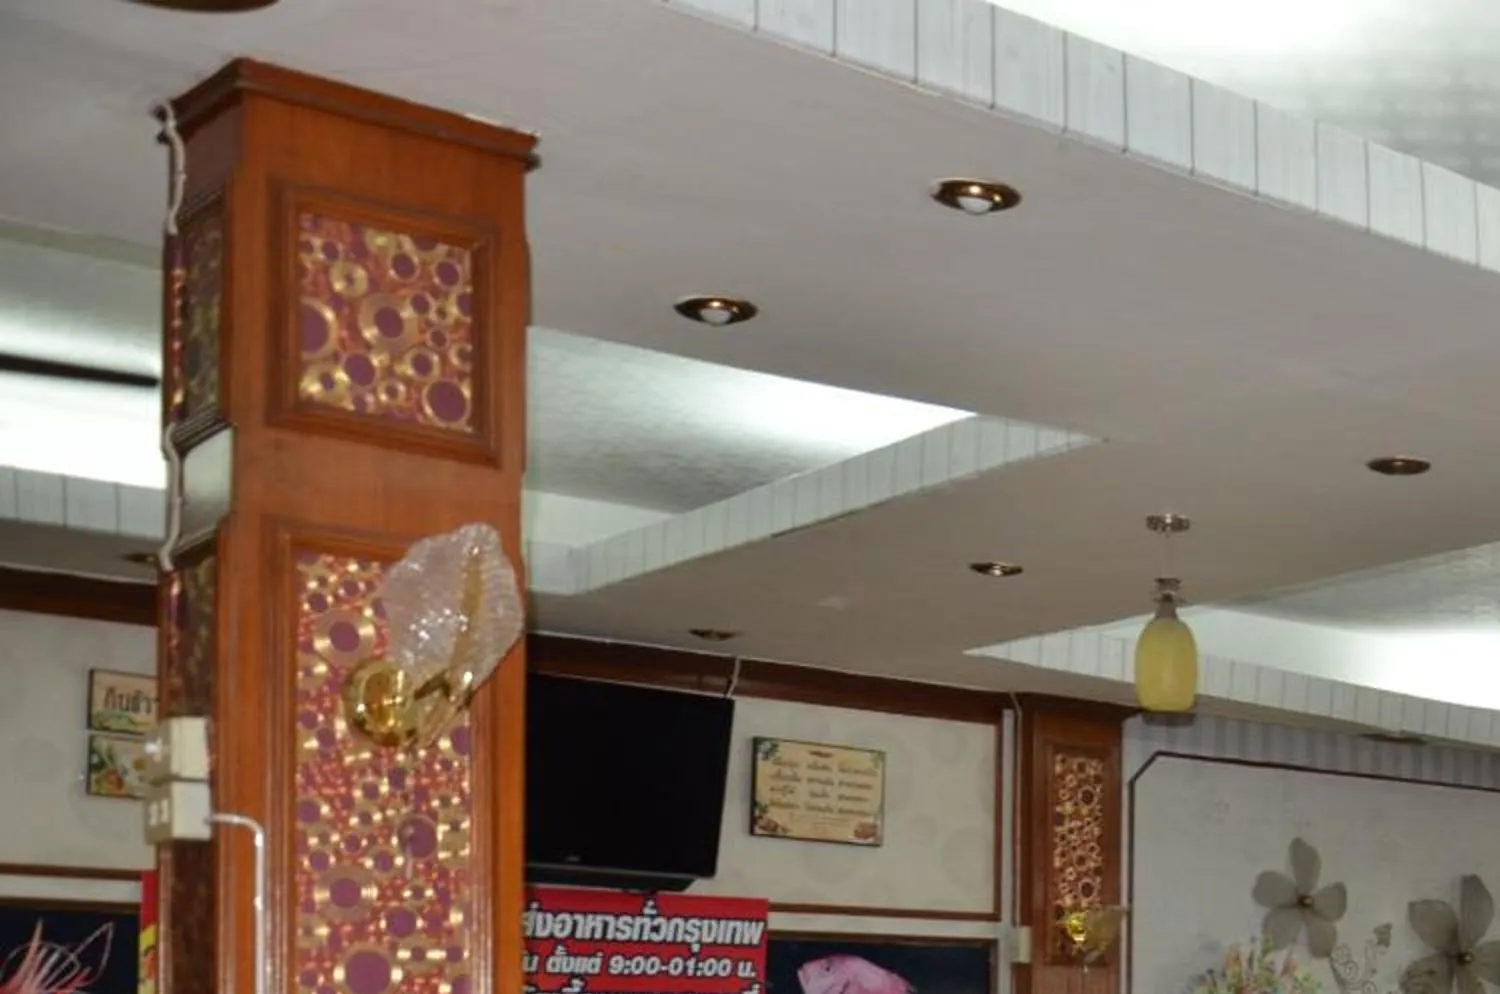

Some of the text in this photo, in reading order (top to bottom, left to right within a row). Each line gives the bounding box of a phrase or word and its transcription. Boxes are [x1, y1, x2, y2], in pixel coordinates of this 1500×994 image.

[546, 945, 604, 974] ตั้งแต่
[608, 955, 731, 978] 9:00-01:00
[738, 961, 757, 978] น.
